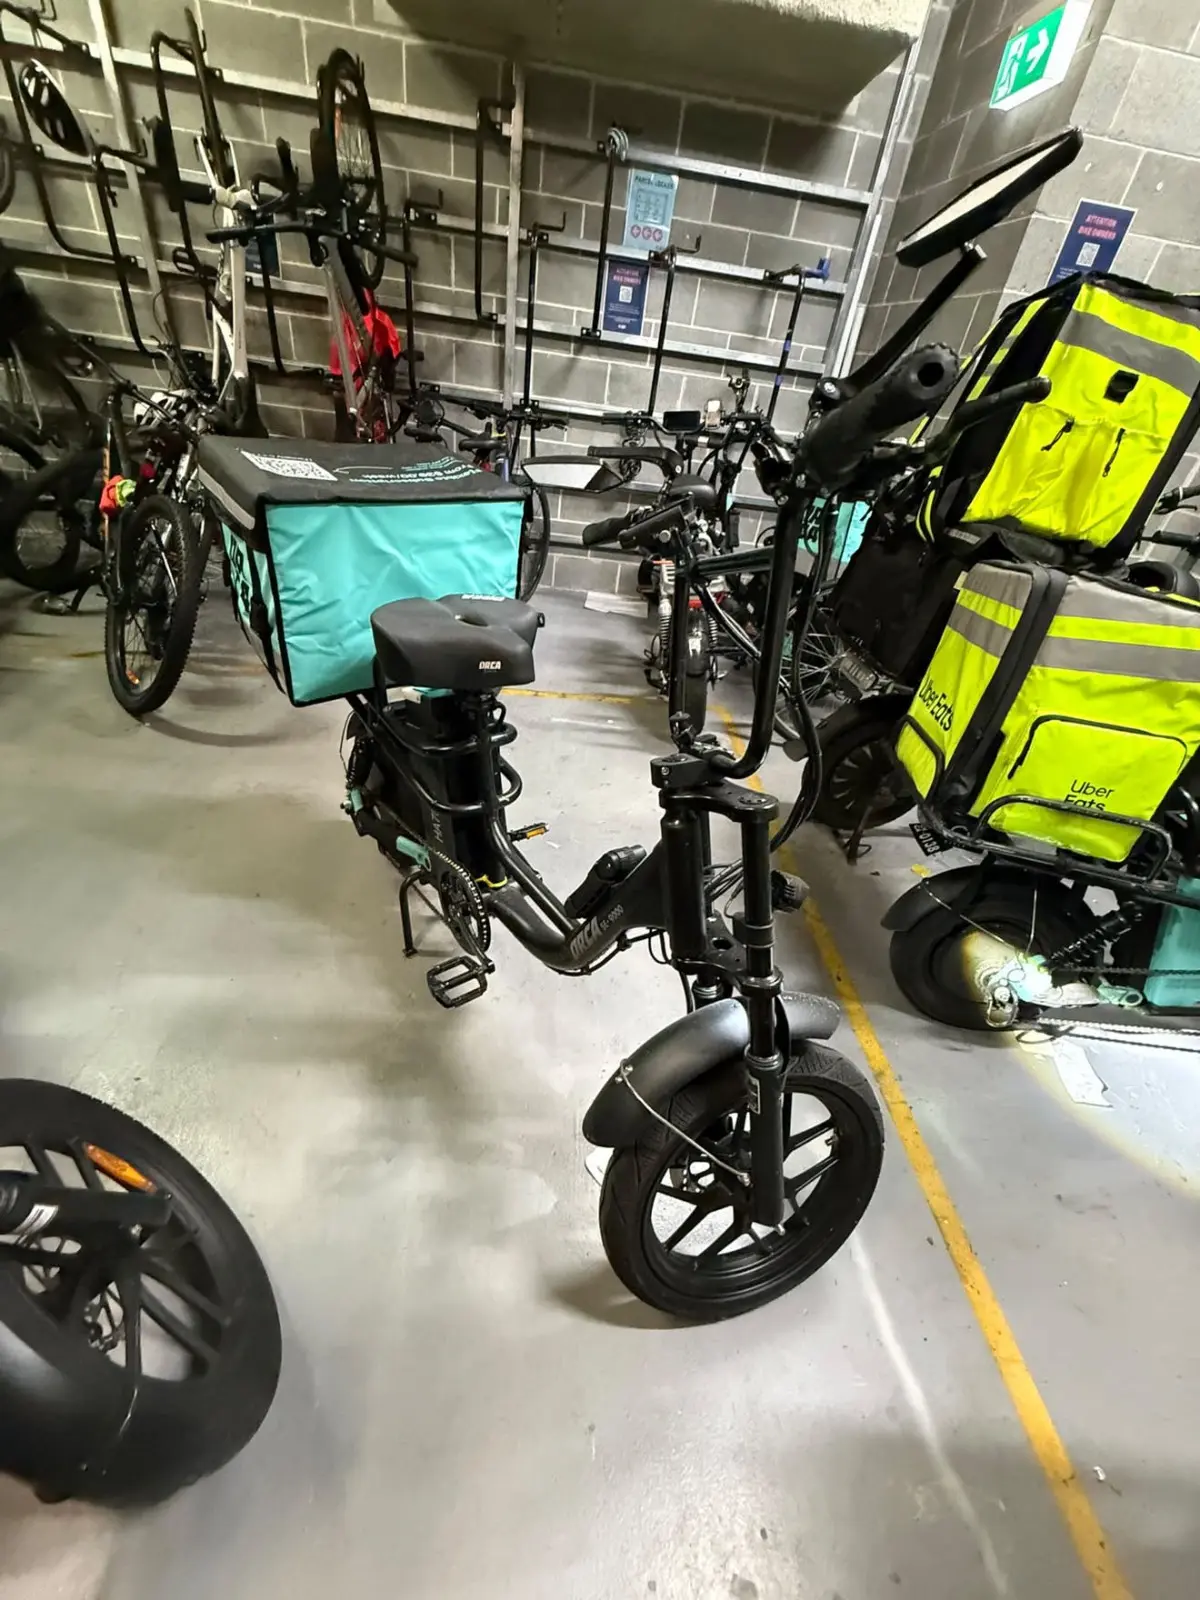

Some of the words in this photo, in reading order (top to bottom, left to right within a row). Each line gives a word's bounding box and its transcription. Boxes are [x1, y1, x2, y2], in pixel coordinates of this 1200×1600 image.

[1085, 214, 1117, 228] ATTENTION
[478, 660, 502, 670] ORCA
[930, 692, 954, 732] Eats
[1070, 779, 1116, 799] Uber
[570, 915, 603, 961] ORCA
